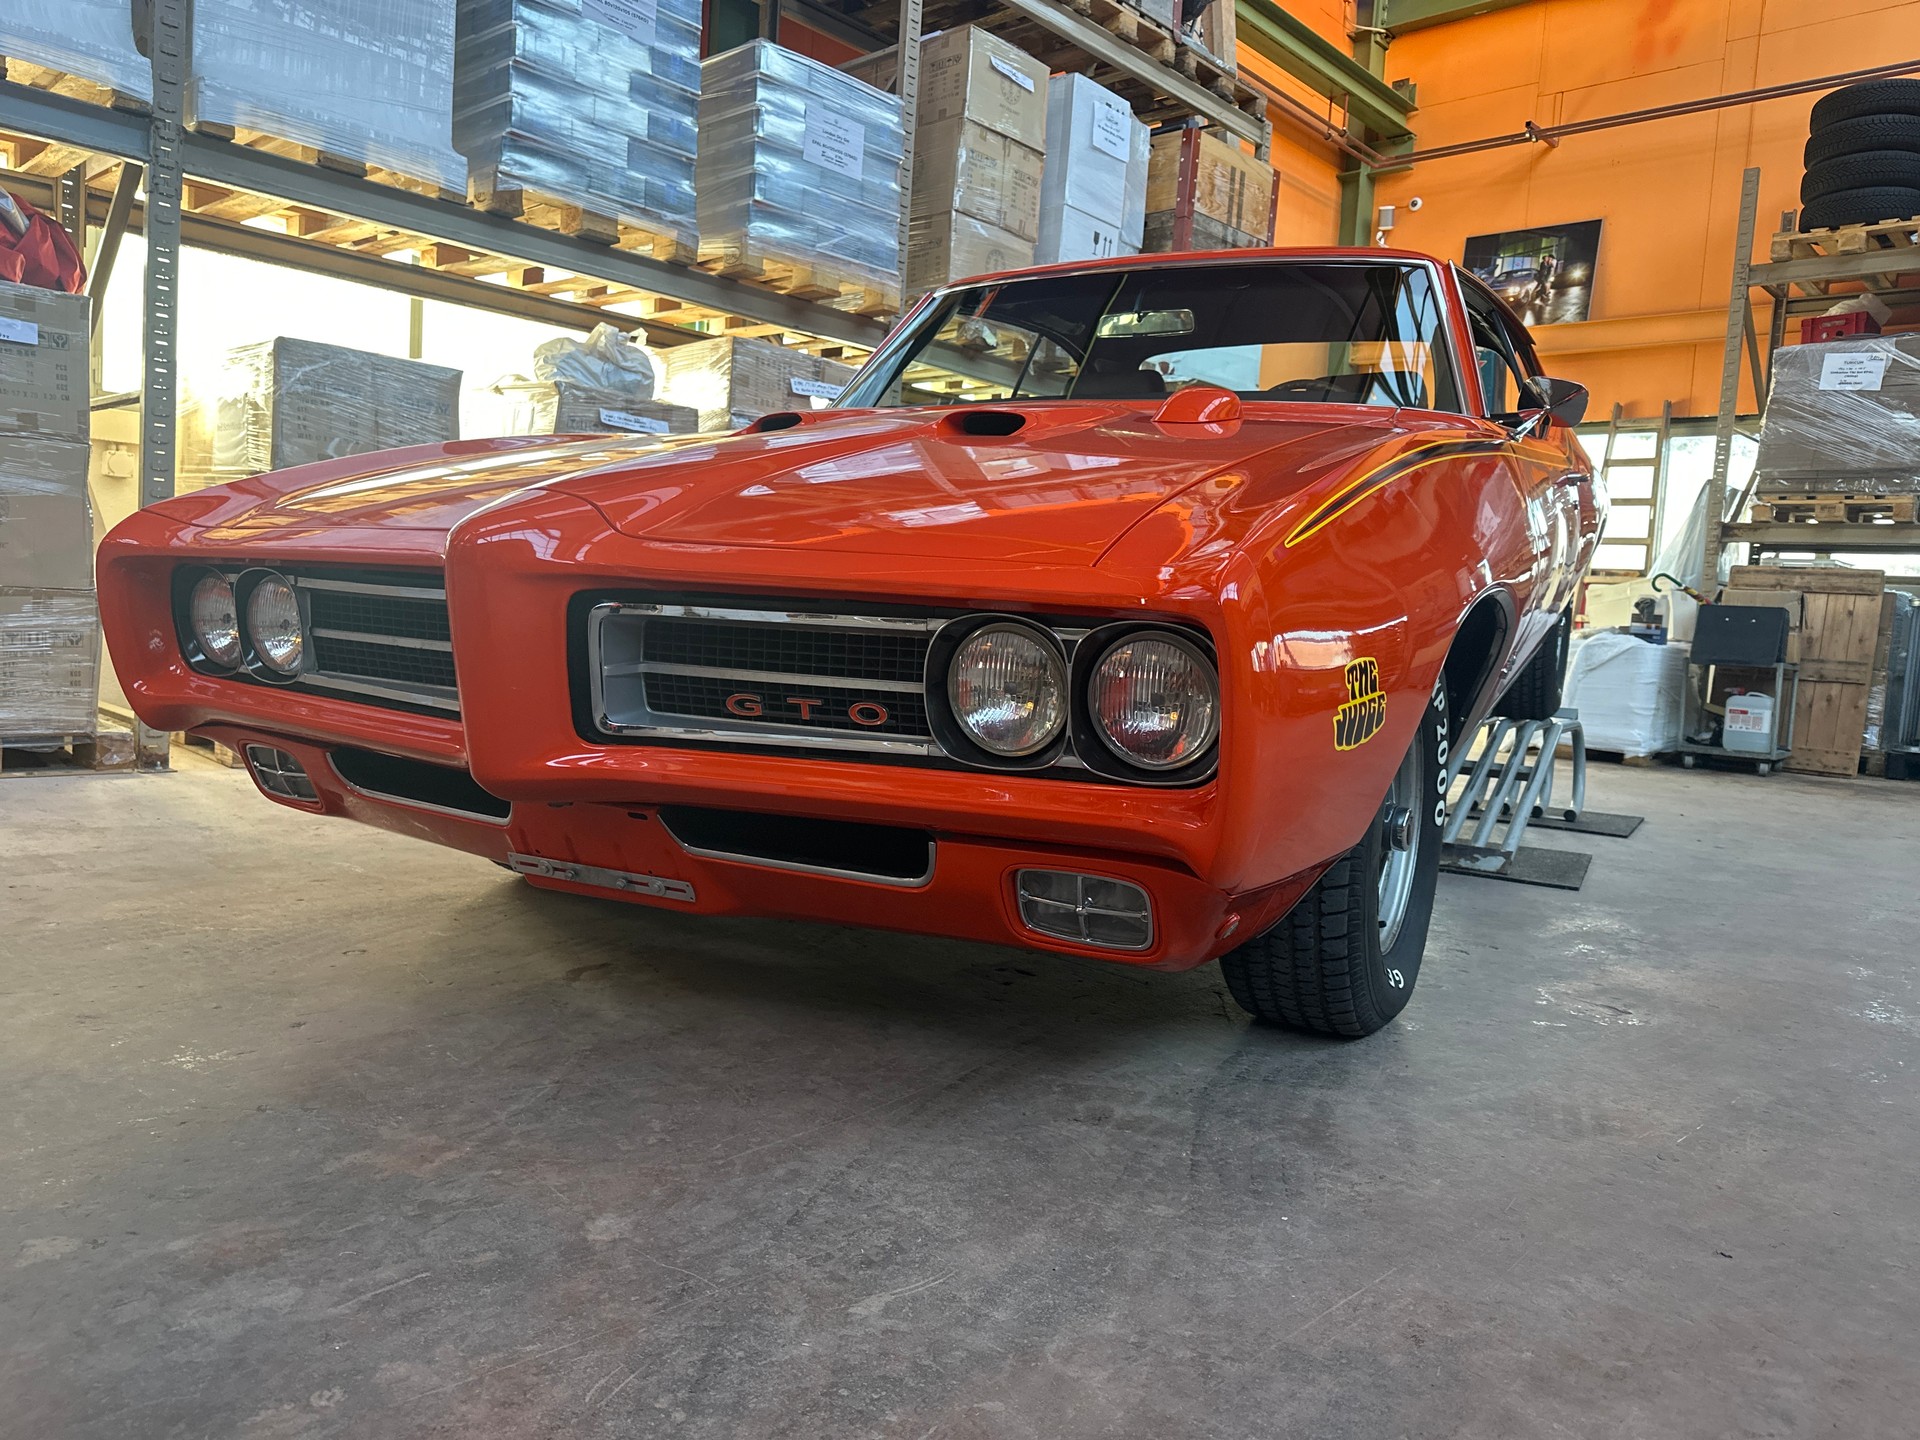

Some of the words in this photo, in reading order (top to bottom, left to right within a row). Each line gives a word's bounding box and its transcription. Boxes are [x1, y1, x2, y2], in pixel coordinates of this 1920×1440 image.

[1345, 658, 1378, 701] THE
[725, 693, 889, 726] GTO
[1334, 692, 1387, 749] JUDGE
[1434, 717, 1449, 827] 2000
